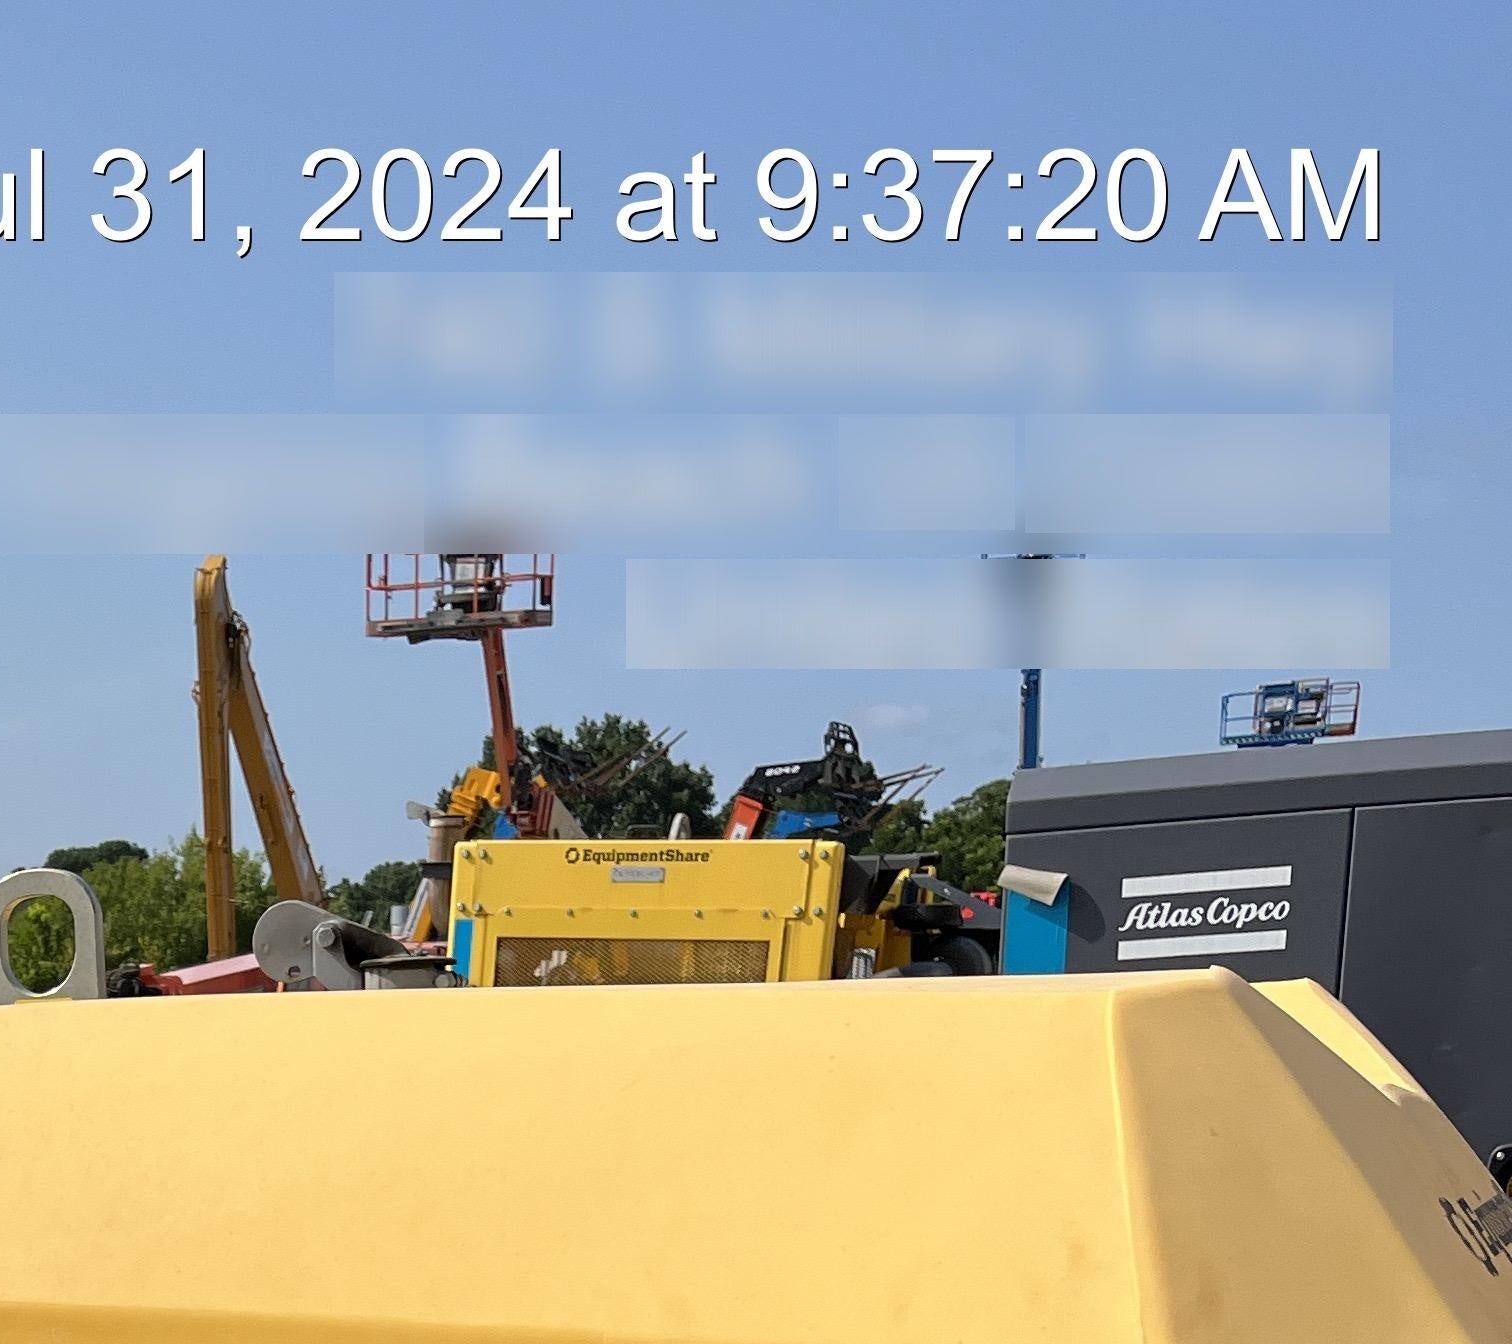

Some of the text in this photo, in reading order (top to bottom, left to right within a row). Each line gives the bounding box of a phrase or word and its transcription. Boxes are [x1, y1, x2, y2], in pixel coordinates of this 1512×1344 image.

[582, 848, 710, 865] EquipmentShare
[1118, 896, 1291, 932] Atlas Copco
